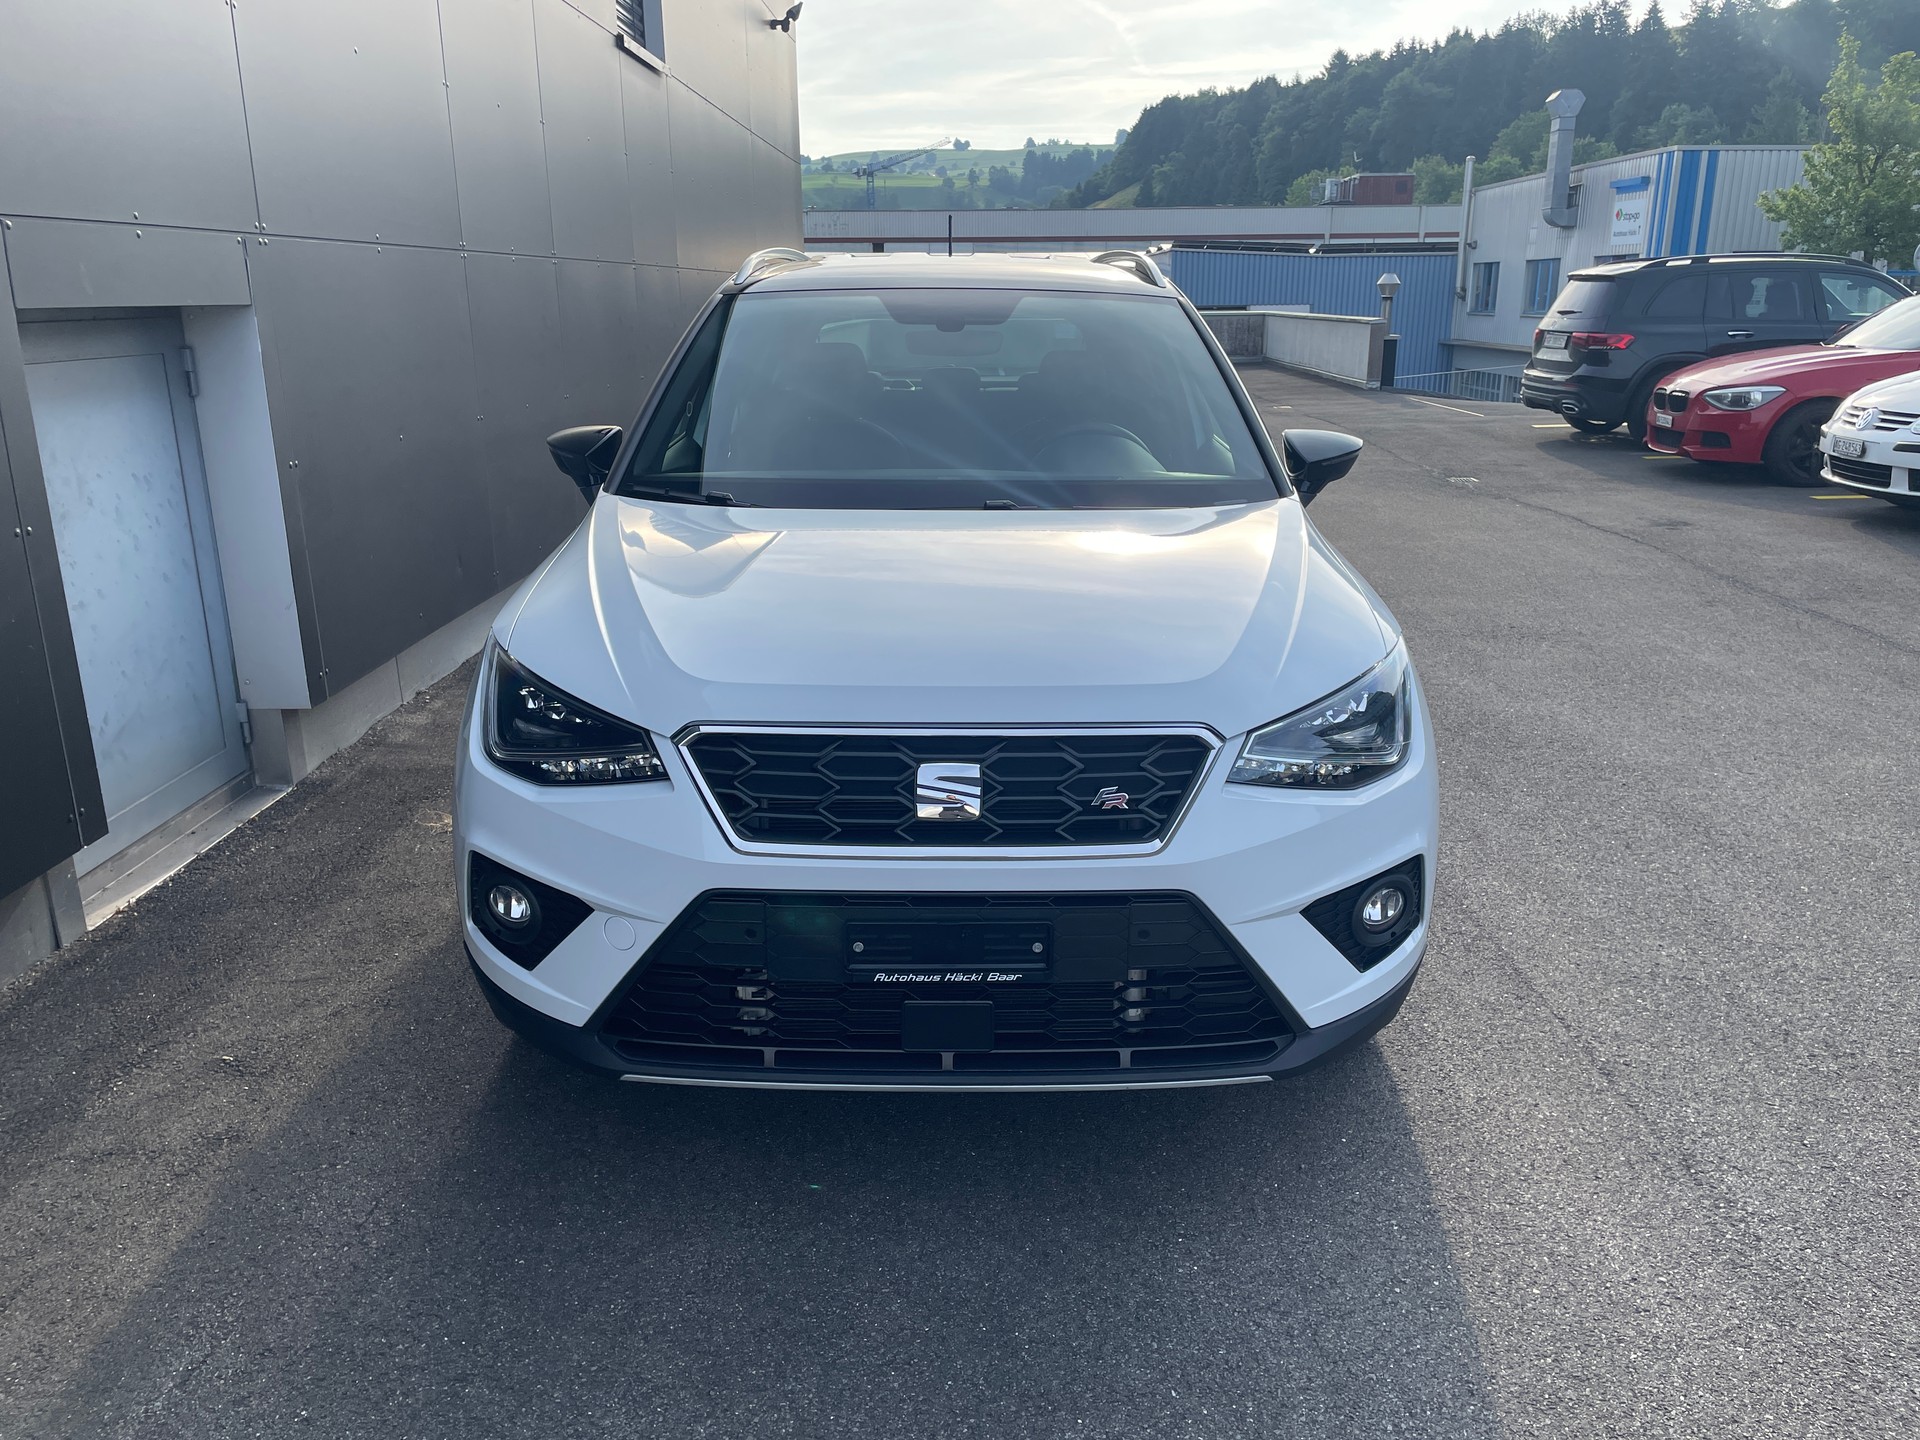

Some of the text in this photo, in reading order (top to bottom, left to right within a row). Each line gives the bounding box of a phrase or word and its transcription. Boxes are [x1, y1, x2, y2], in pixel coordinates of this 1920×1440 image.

[1091, 786, 1129, 809] FR
[873, 972, 1023, 982] Autohaus Häcki Baar
